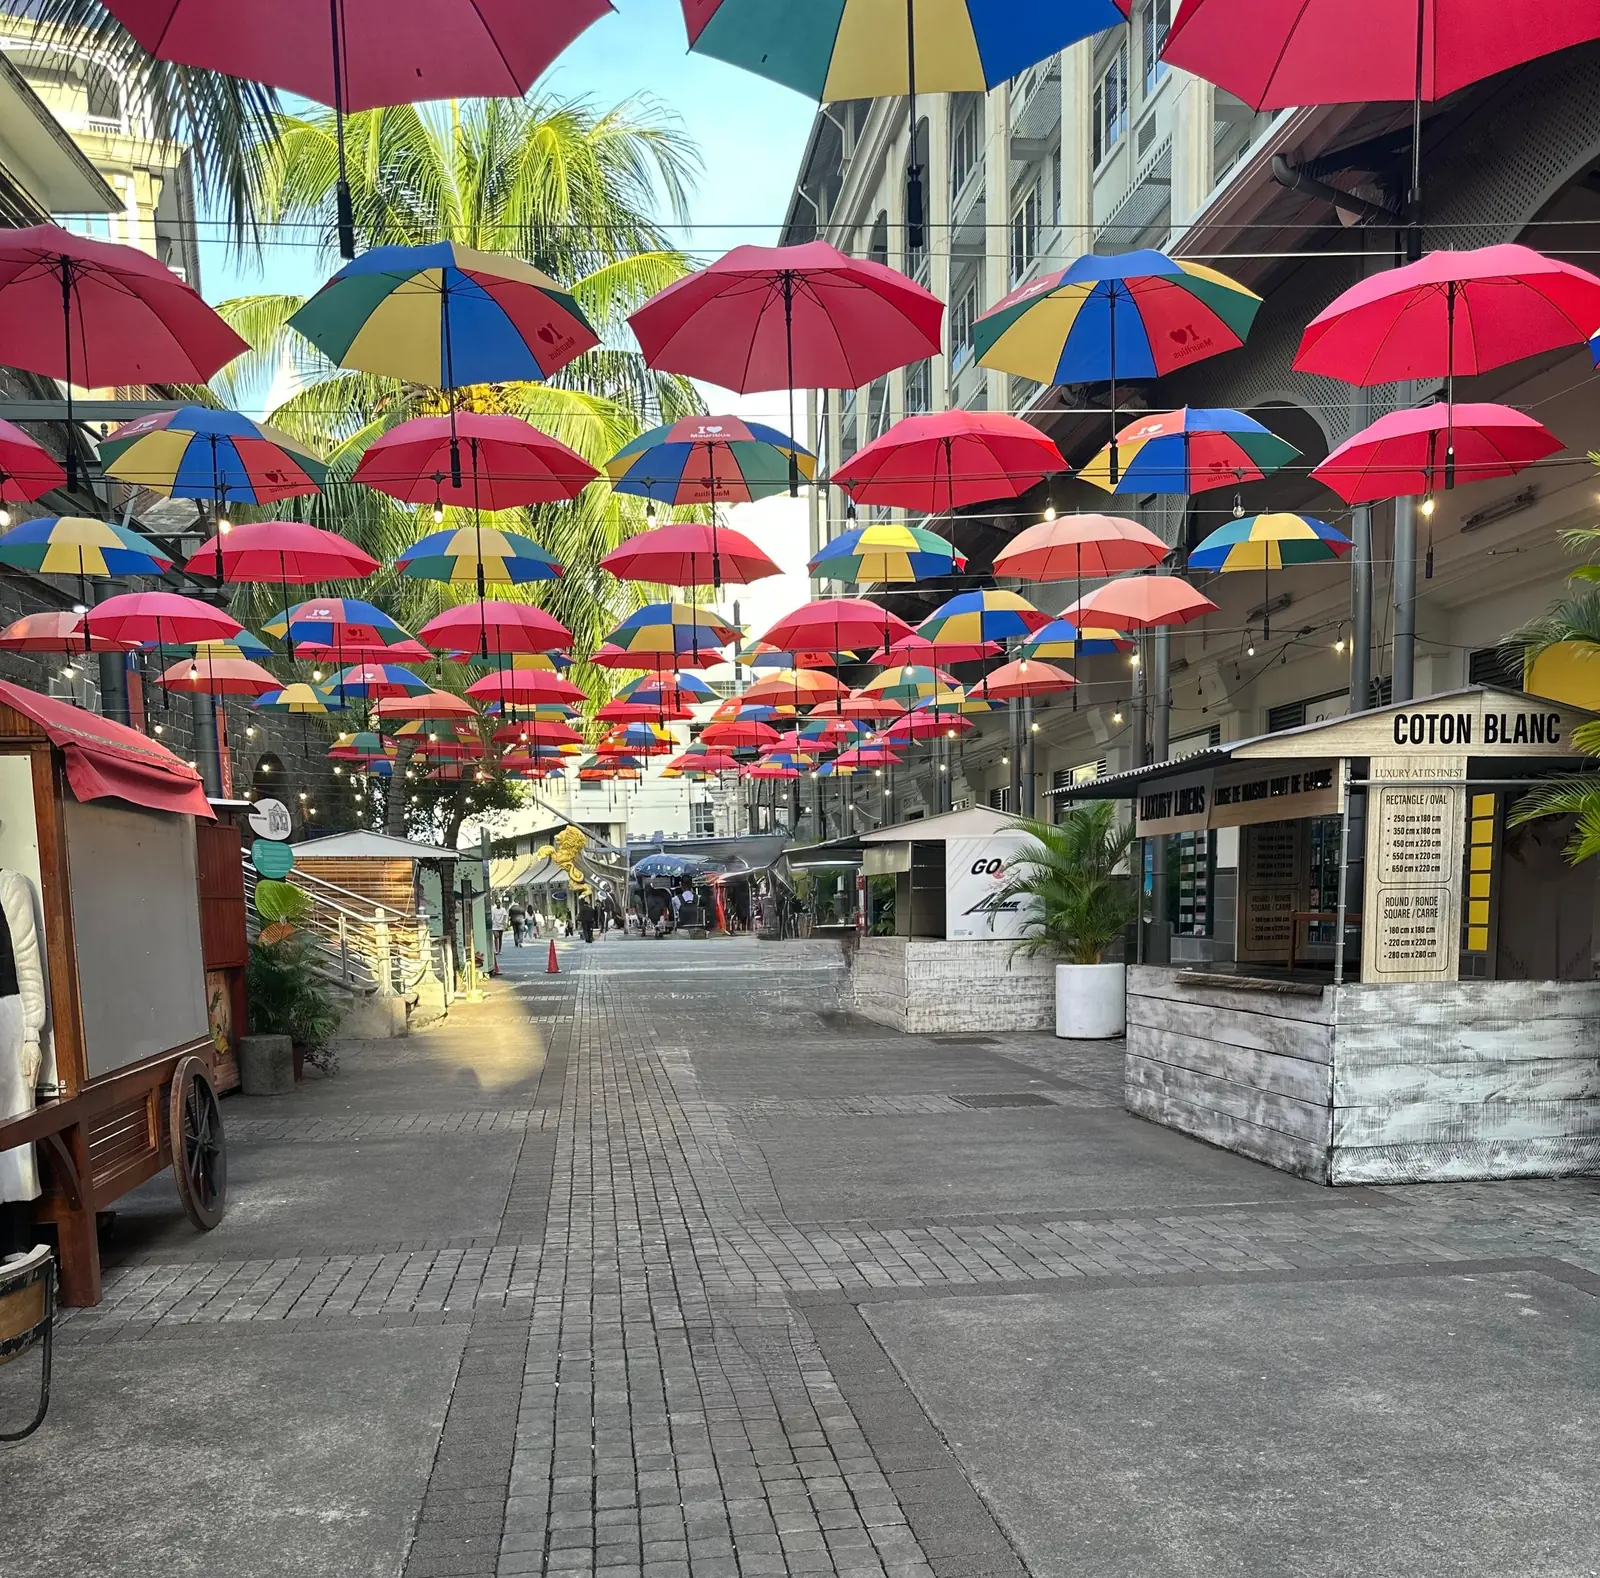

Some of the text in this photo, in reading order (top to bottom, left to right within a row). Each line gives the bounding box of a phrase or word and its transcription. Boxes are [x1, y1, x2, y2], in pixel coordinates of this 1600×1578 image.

[1393, 713, 1561, 745] COTON BLANC
[1375, 769, 1463, 778] LUXURY AT ITS FINEST
[1386, 795, 1424, 805] RECTANGLE
[1431, 795, 1447, 804] OVAL
[1140, 791, 1173, 821] LUXURY
[1393, 827, 1404, 835] 350
[1421, 827, 1430, 835] 180
[970, 858, 1002, 875] GO
[960, 892, 1022, 916] ANME
[1386, 897, 1409, 907] ROUND
[1416, 896, 1438, 906] RONDE
[1384, 909, 1410, 919] SQUARE
[1417, 908, 1438, 918] CARRE
